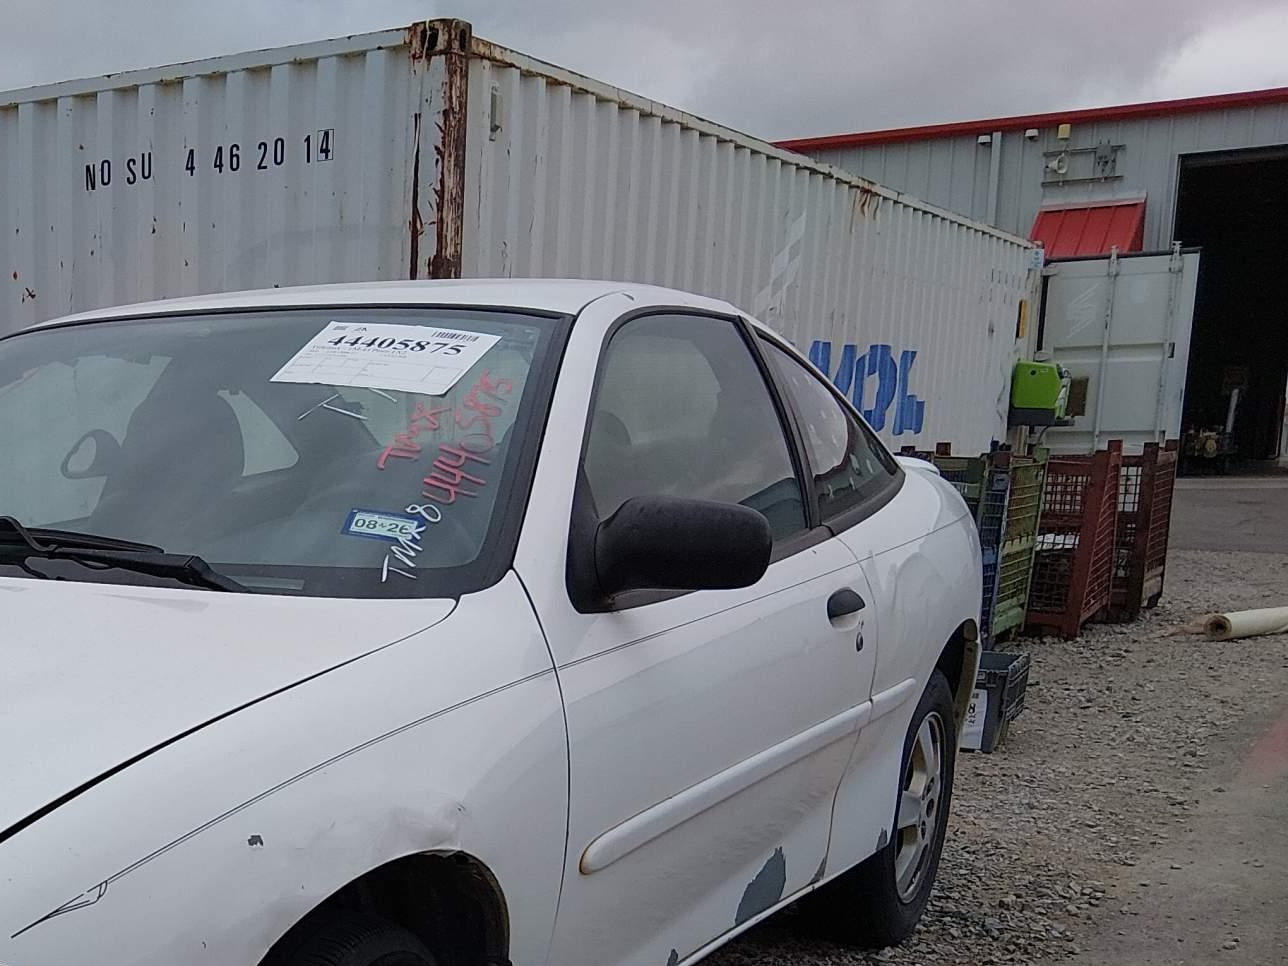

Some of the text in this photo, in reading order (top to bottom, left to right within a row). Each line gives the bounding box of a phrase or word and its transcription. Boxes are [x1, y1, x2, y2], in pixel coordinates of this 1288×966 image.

[85, 129, 333, 191] NO SU 4 46 20 14
[328, 334, 467, 356] 44405875
[354, 518, 410, 536] 08 26
